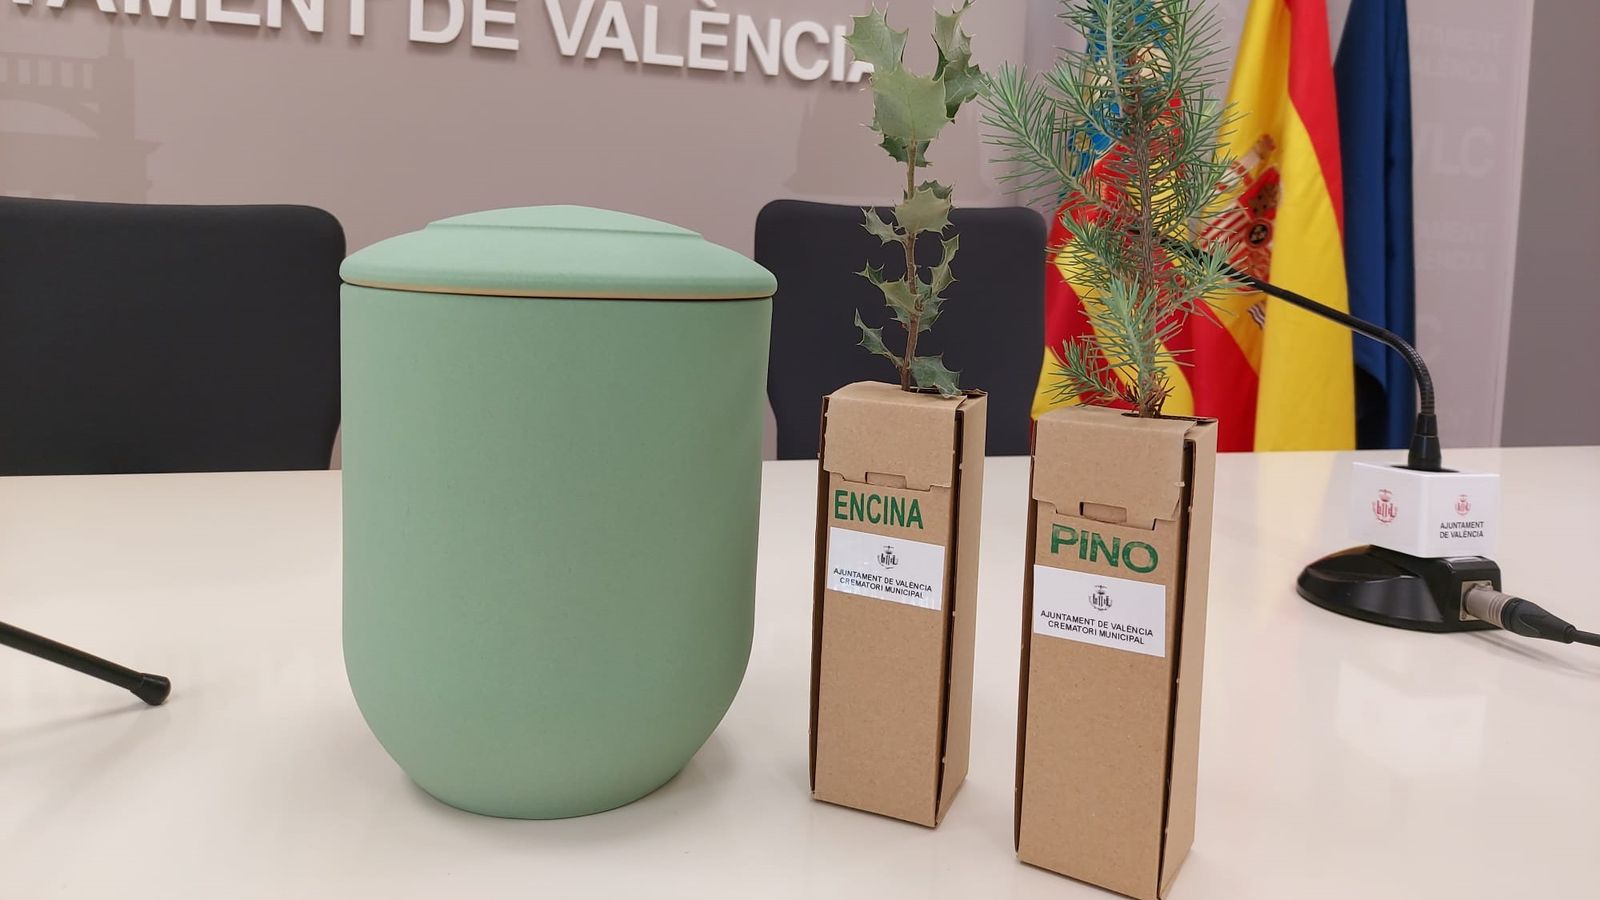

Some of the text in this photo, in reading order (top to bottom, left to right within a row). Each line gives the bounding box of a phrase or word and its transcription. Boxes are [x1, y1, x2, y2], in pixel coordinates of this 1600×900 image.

[408, 0, 519, 50] DE
[834, 490, 924, 530] ENCINA
[1439, 531, 1449, 539] DE
[1440, 521, 1485, 530] AJUNTAMENT
[1050, 523, 1159, 574] PINO
[833, 567, 883, 582] AJUNTAMENT
[884, 576, 894, 585] DE
[839, 577, 924, 599] CREMATORI MUNICIPAL
[1040, 610, 1096, 627] AJUNTAMENT
[1097, 620, 1109, 629] DE
[1048, 620, 1145, 645] CREMATORI MUNICIPAL
